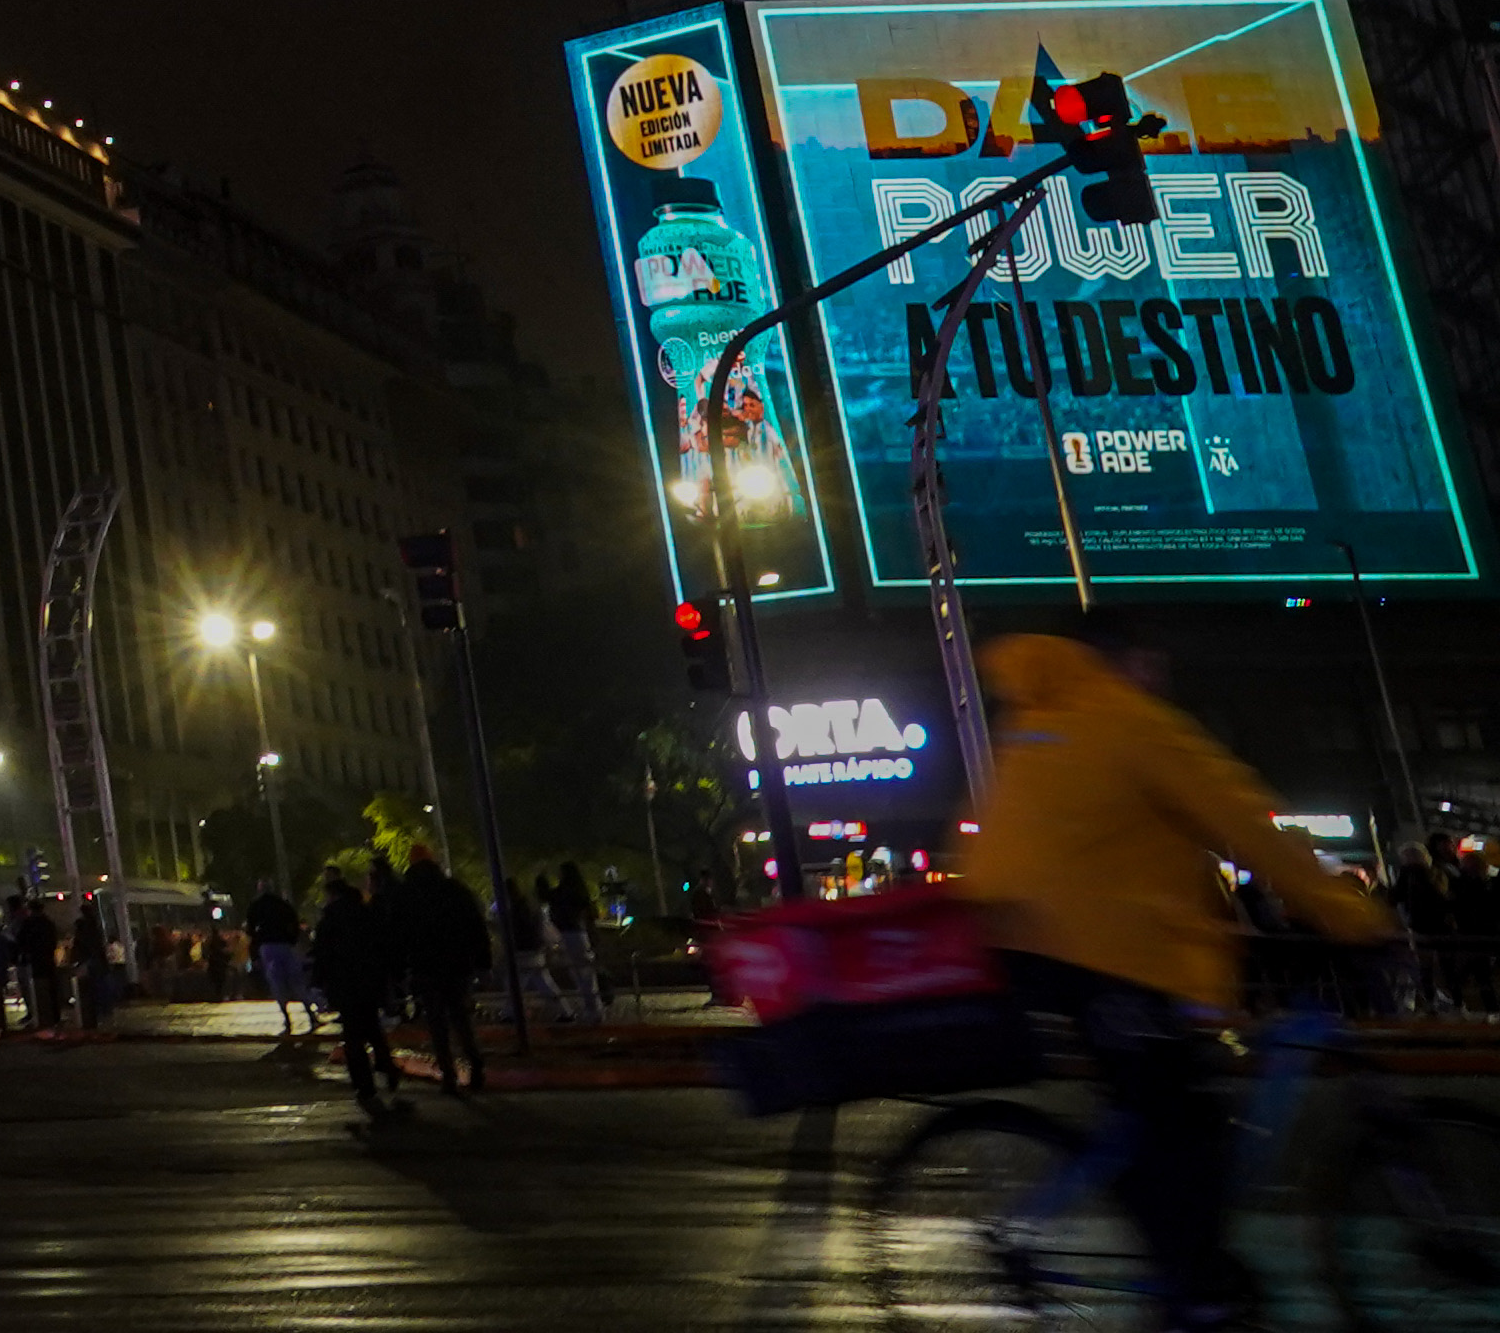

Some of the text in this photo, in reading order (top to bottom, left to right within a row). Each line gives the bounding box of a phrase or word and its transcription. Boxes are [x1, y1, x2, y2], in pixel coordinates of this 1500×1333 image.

[619, 70, 704, 118] NUEVA
[639, 110, 693, 138] EDICIÓN
[856, 73, 1295, 160] DAE
[640, 130, 702, 159] LIMITADA
[871, 171, 1330, 285] POWER
[961, 298, 1049, 399] TU
[1054, 294, 1356, 398] DESTINO
[1095, 429, 1188, 453] POWER
[1100, 451, 1153, 474] ADE
